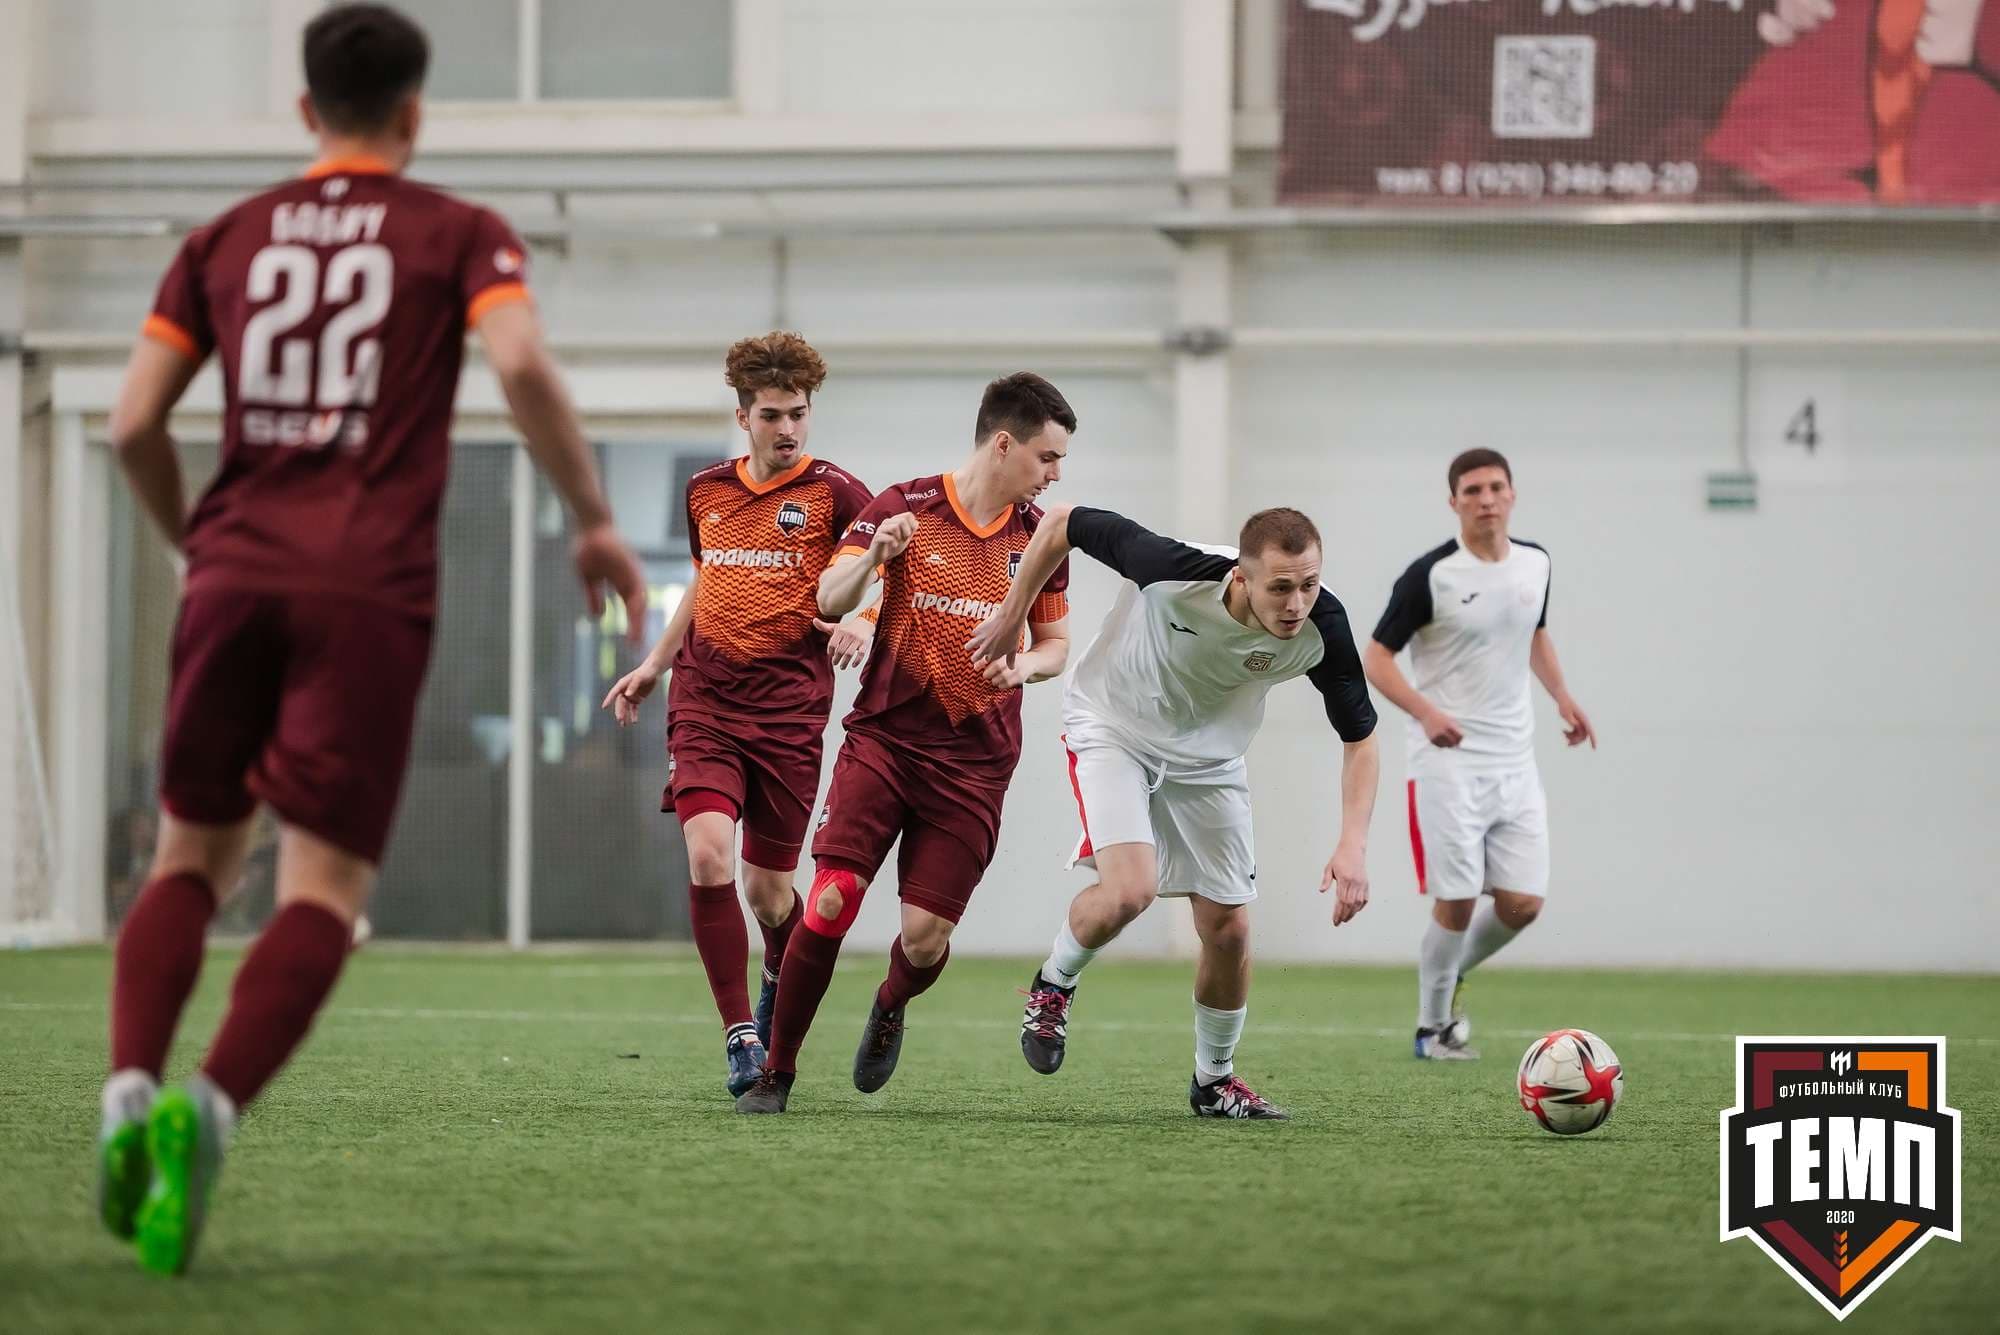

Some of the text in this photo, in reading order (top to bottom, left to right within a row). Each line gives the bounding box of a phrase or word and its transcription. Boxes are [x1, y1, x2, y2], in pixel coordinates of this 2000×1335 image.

[239, 244, 394, 406] 22
[1784, 400, 1820, 453] 4
[780, 511, 805, 527] ТЕМП
